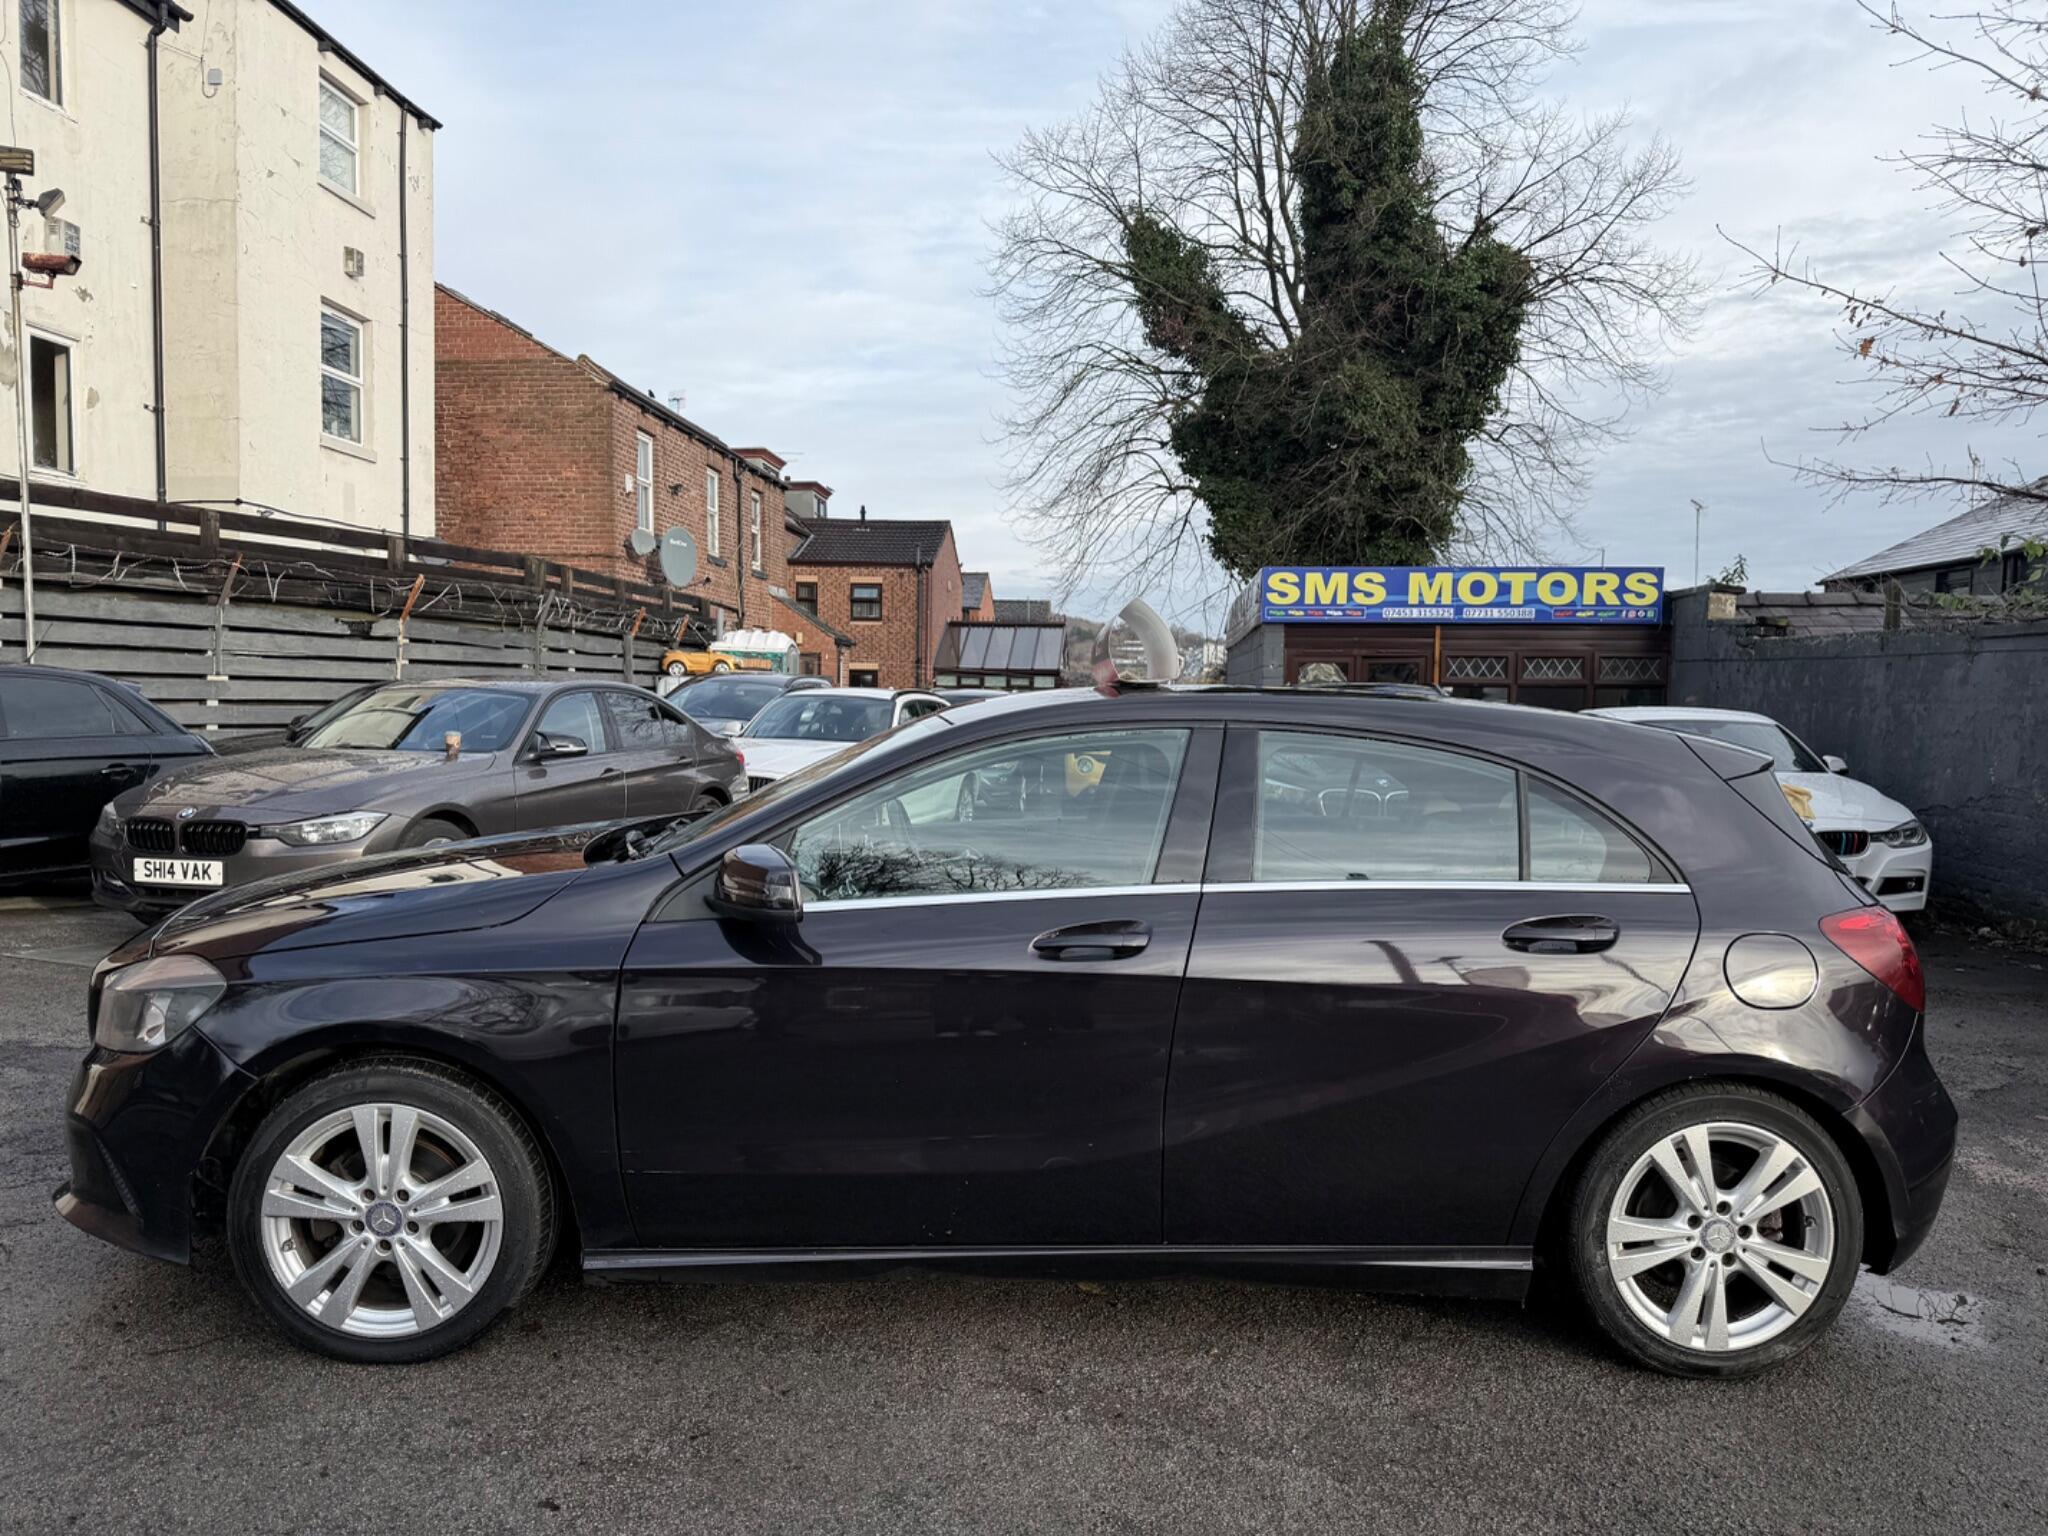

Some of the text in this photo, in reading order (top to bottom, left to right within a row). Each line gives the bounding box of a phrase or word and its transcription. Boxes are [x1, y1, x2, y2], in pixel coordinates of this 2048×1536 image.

[1266, 572, 1659, 605] SMS MOTORS
[144, 861, 212, 880] SH14 VAK
